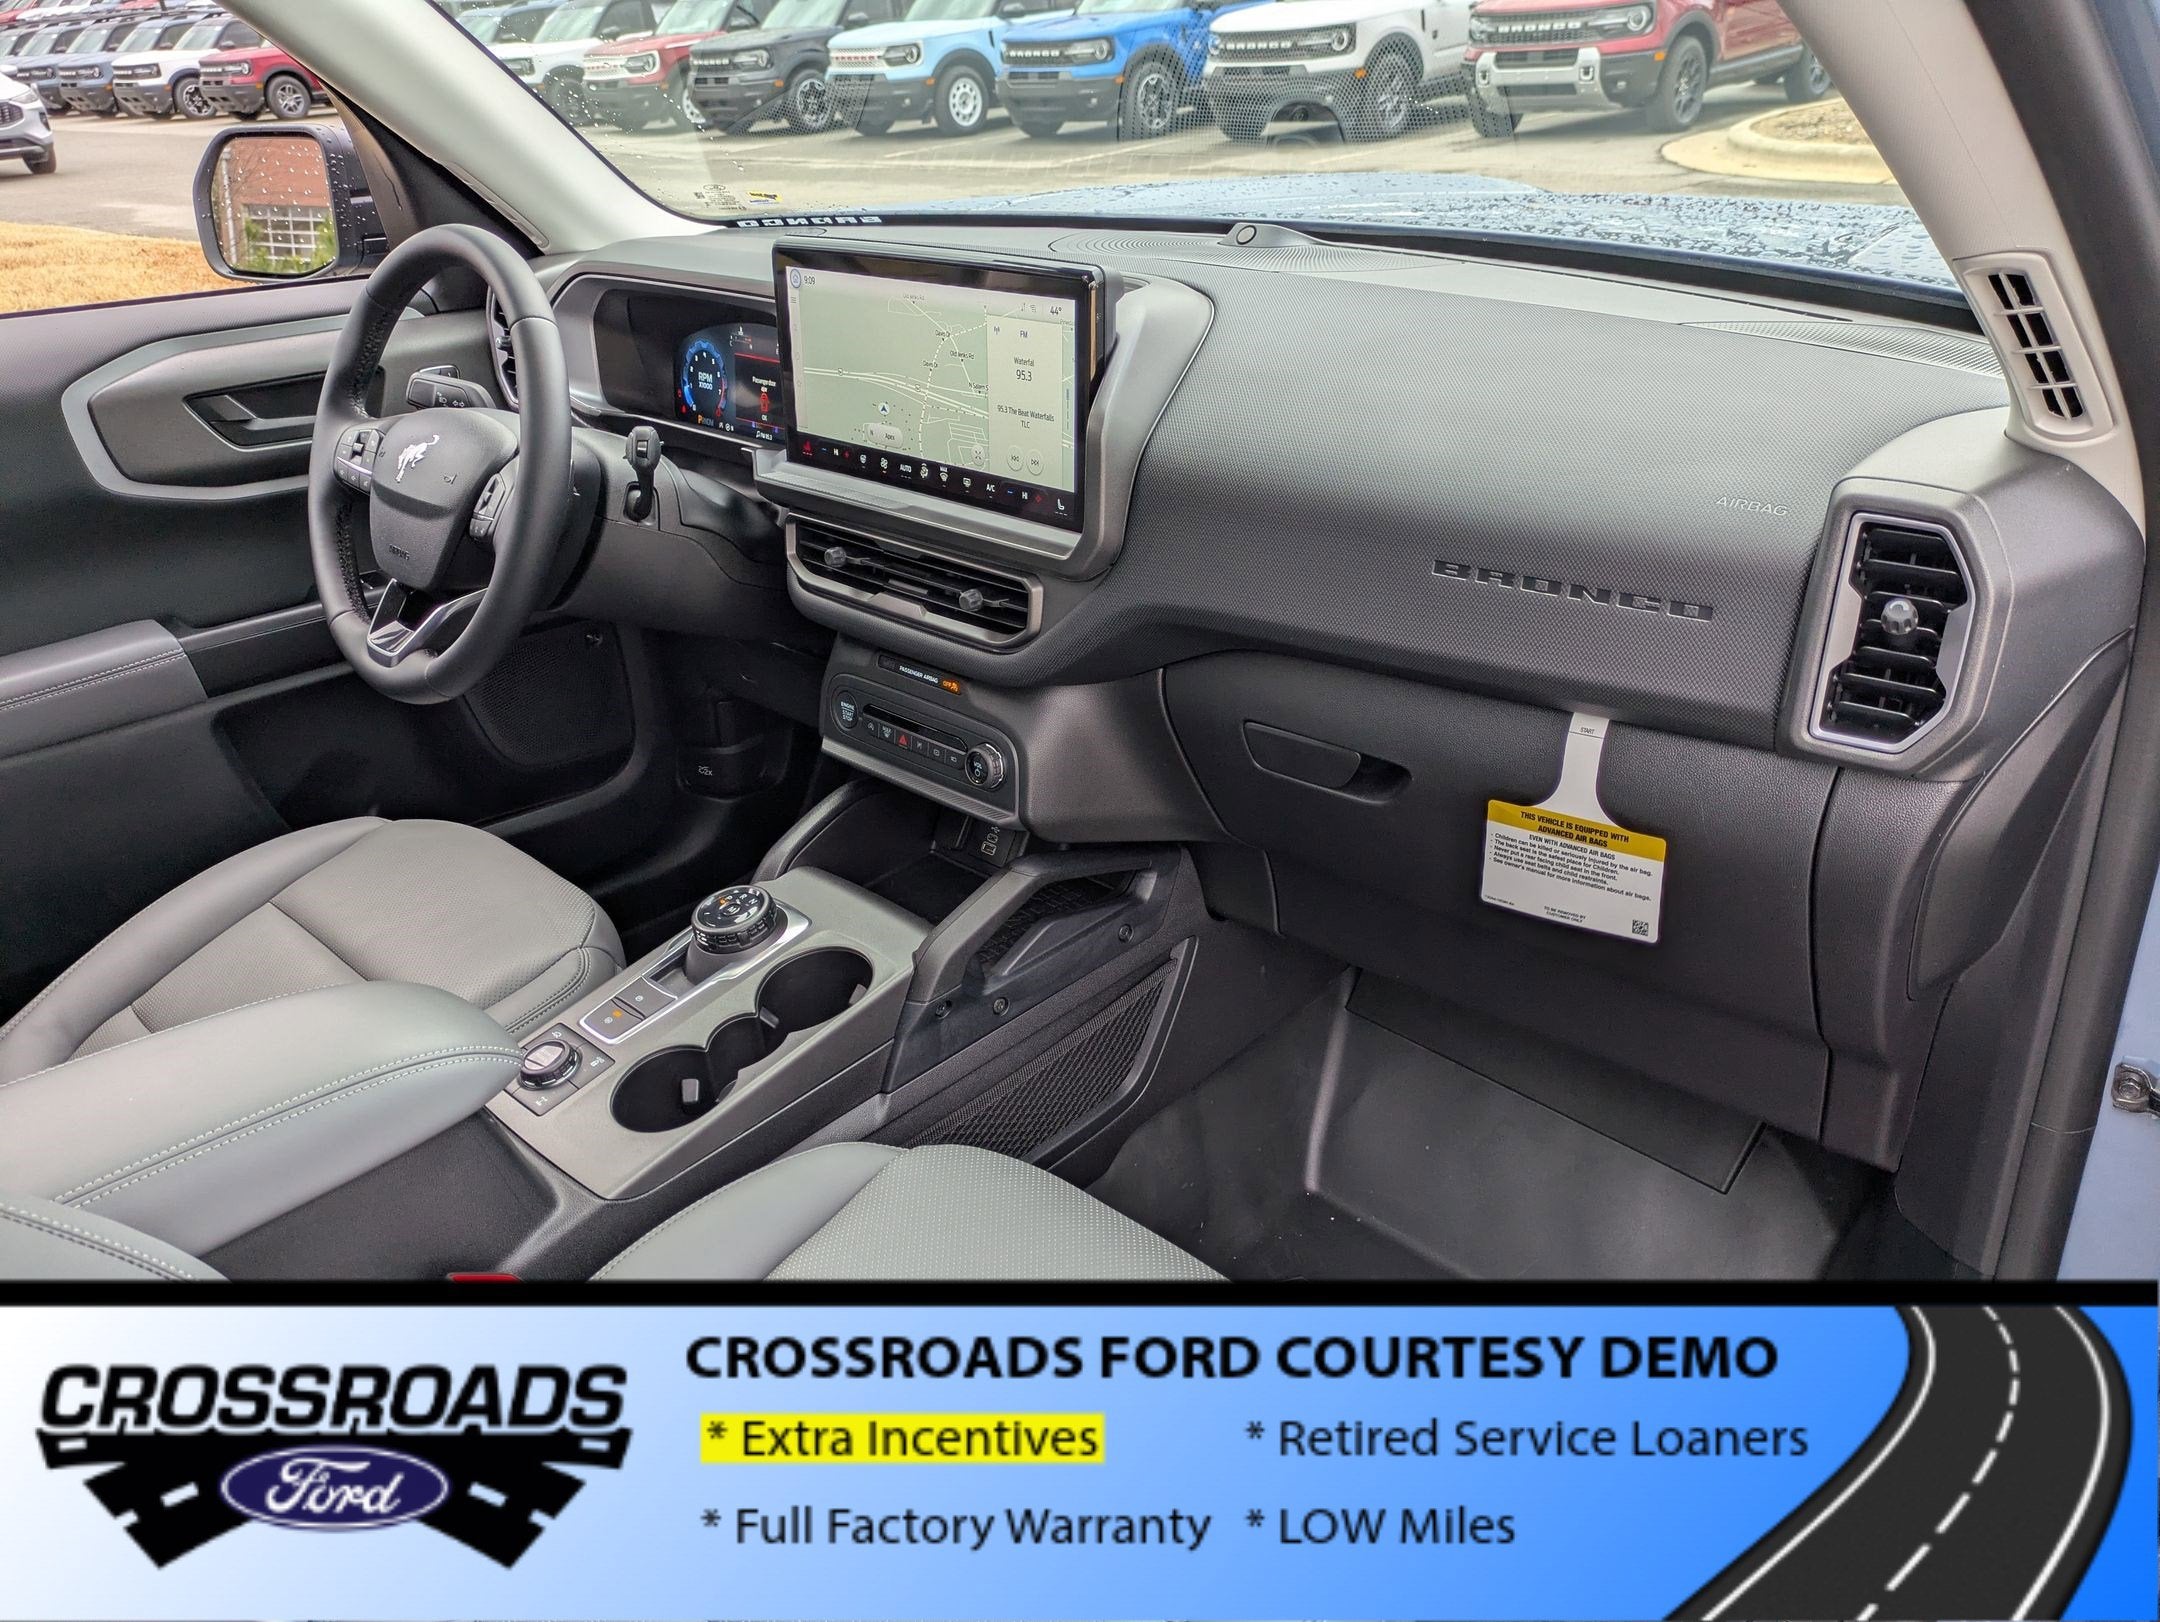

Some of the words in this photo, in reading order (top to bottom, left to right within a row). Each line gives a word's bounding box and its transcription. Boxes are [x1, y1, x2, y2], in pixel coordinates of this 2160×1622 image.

[1498, 22, 1581, 33] BRONCO
[804, 275, 816, 285] 9:09
[1020, 330, 1028, 339] FM
[698, 372, 713, 383] RPM
[1016, 369, 1032, 382] 95.3
[998, 404, 1008, 414] 95.3
[1008, 406, 1018, 414] The
[1018, 408, 1029, 417] Beat
[1030, 410, 1054, 422] Waterfalls
[1021, 420, 1030, 428] TLC
[885, 432, 895, 440] Apex
[900, 464, 912, 472] AUTO
[986, 484, 996, 492] A/C
[1716, 496, 1788, 516] AIRBAG
[1432, 559, 1714, 622] BRONCO
[900, 665, 922, 678] PASSENGER
[924, 674, 938, 684] AIRBAG
[840, 702, 854, 710] ENGINE
[1580, 726, 1595, 734] START
[1521, 811, 1536, 820] THIS
[1538, 815, 1564, 827] VEHICLE
[1566, 822, 1573, 830] IS
[1574, 824, 1608, 838] EQUIPPED
[1611, 832, 1630, 843] WITH
[1538, 825, 1574, 840] ADVANCED
[1575, 834, 1588, 843] AIR
[1589, 837, 1608, 848] BAGS
[1494, 832, 1518, 843] Children
[1518, 838, 1529, 846] can
[1538, 844, 1552, 852] killed
[1561, 850, 1588, 861] seriously
[1588, 856, 1609, 867] injured
[1529, 834, 1542, 842] EVEN
[1544, 838, 1558, 846] WITH
[1559, 842, 1588, 854] ADVANCED
[1600, 852, 1616, 860] BAGS
[1494, 838, 1504, 846] The
[1506, 842, 1518, 850] back
[1548, 854, 1565, 862] safest
[1566, 856, 1582, 866] place
[1592, 864, 1620, 875] Children.
[1494, 845, 1510, 854] Never
[1510, 850, 1520, 858] put
[1536, 856, 1554, 866] facing
[1555, 860, 1570, 869] child
[1570, 864, 1582, 872] seat
[1601, 872, 1618, 880] front.
[1494, 851, 1512, 860] Always
[1537, 862, 1550, 870] belts
[1552, 866, 1562, 874] and
[1564, 869, 1578, 878] child
[1579, 874, 1608, 886] restraints.
[1504, 862, 1524, 871] owner's
[1526, 866, 1546, 876] manual
[1556, 874, 1571, 882] more
[1572, 877, 1606, 891] information
[1606, 886, 1624, 896] about
[1634, 892, 1652, 902] bags.
